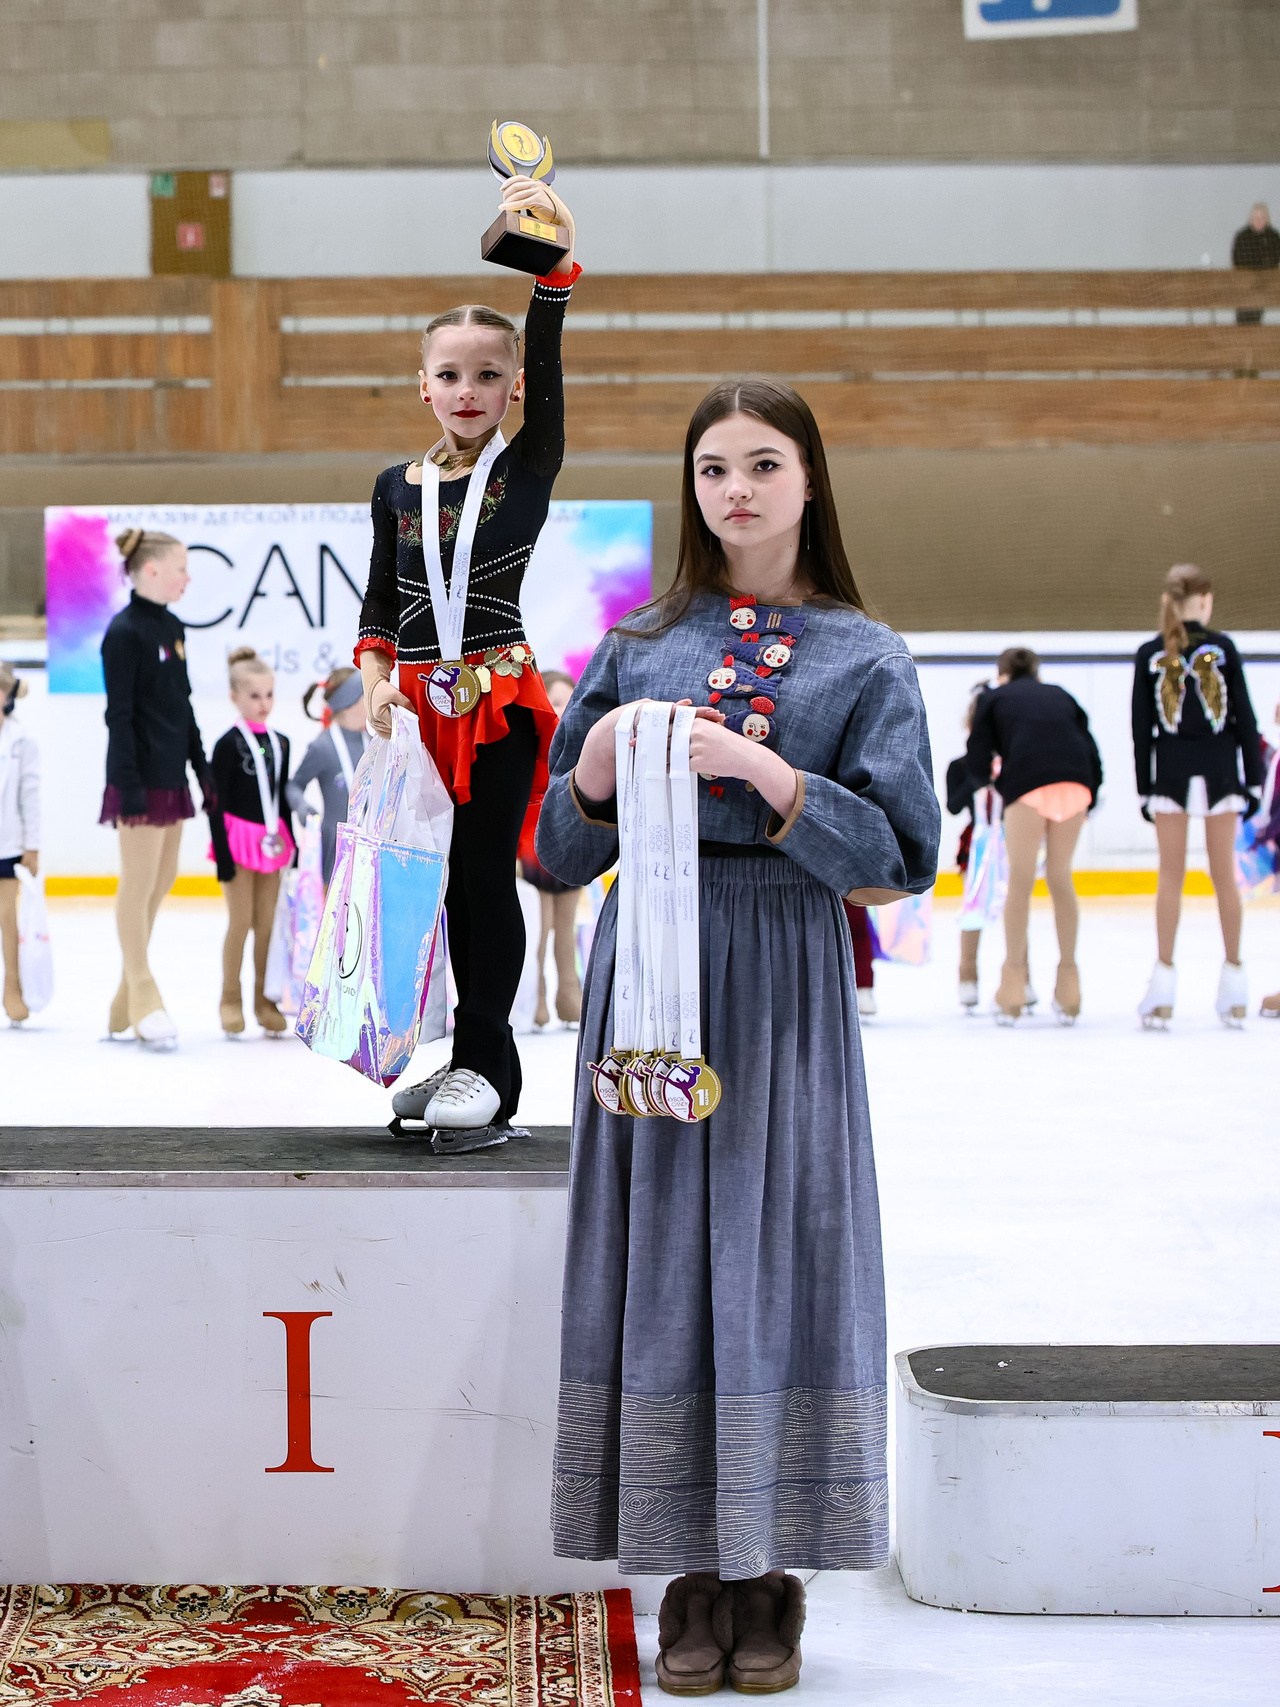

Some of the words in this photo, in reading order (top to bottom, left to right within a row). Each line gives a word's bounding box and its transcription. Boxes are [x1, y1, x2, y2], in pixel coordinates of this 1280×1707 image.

[182, 544, 366, 628] CAN
[456, 687, 465, 703] 1
[648, 825, 656, 853] CANDY
[684, 824, 692, 852] КУБОК
[664, 995, 672, 1023] CANDY
[672, 994, 680, 1023] КУБОК
[695, 1089, 704, 1106] 1
